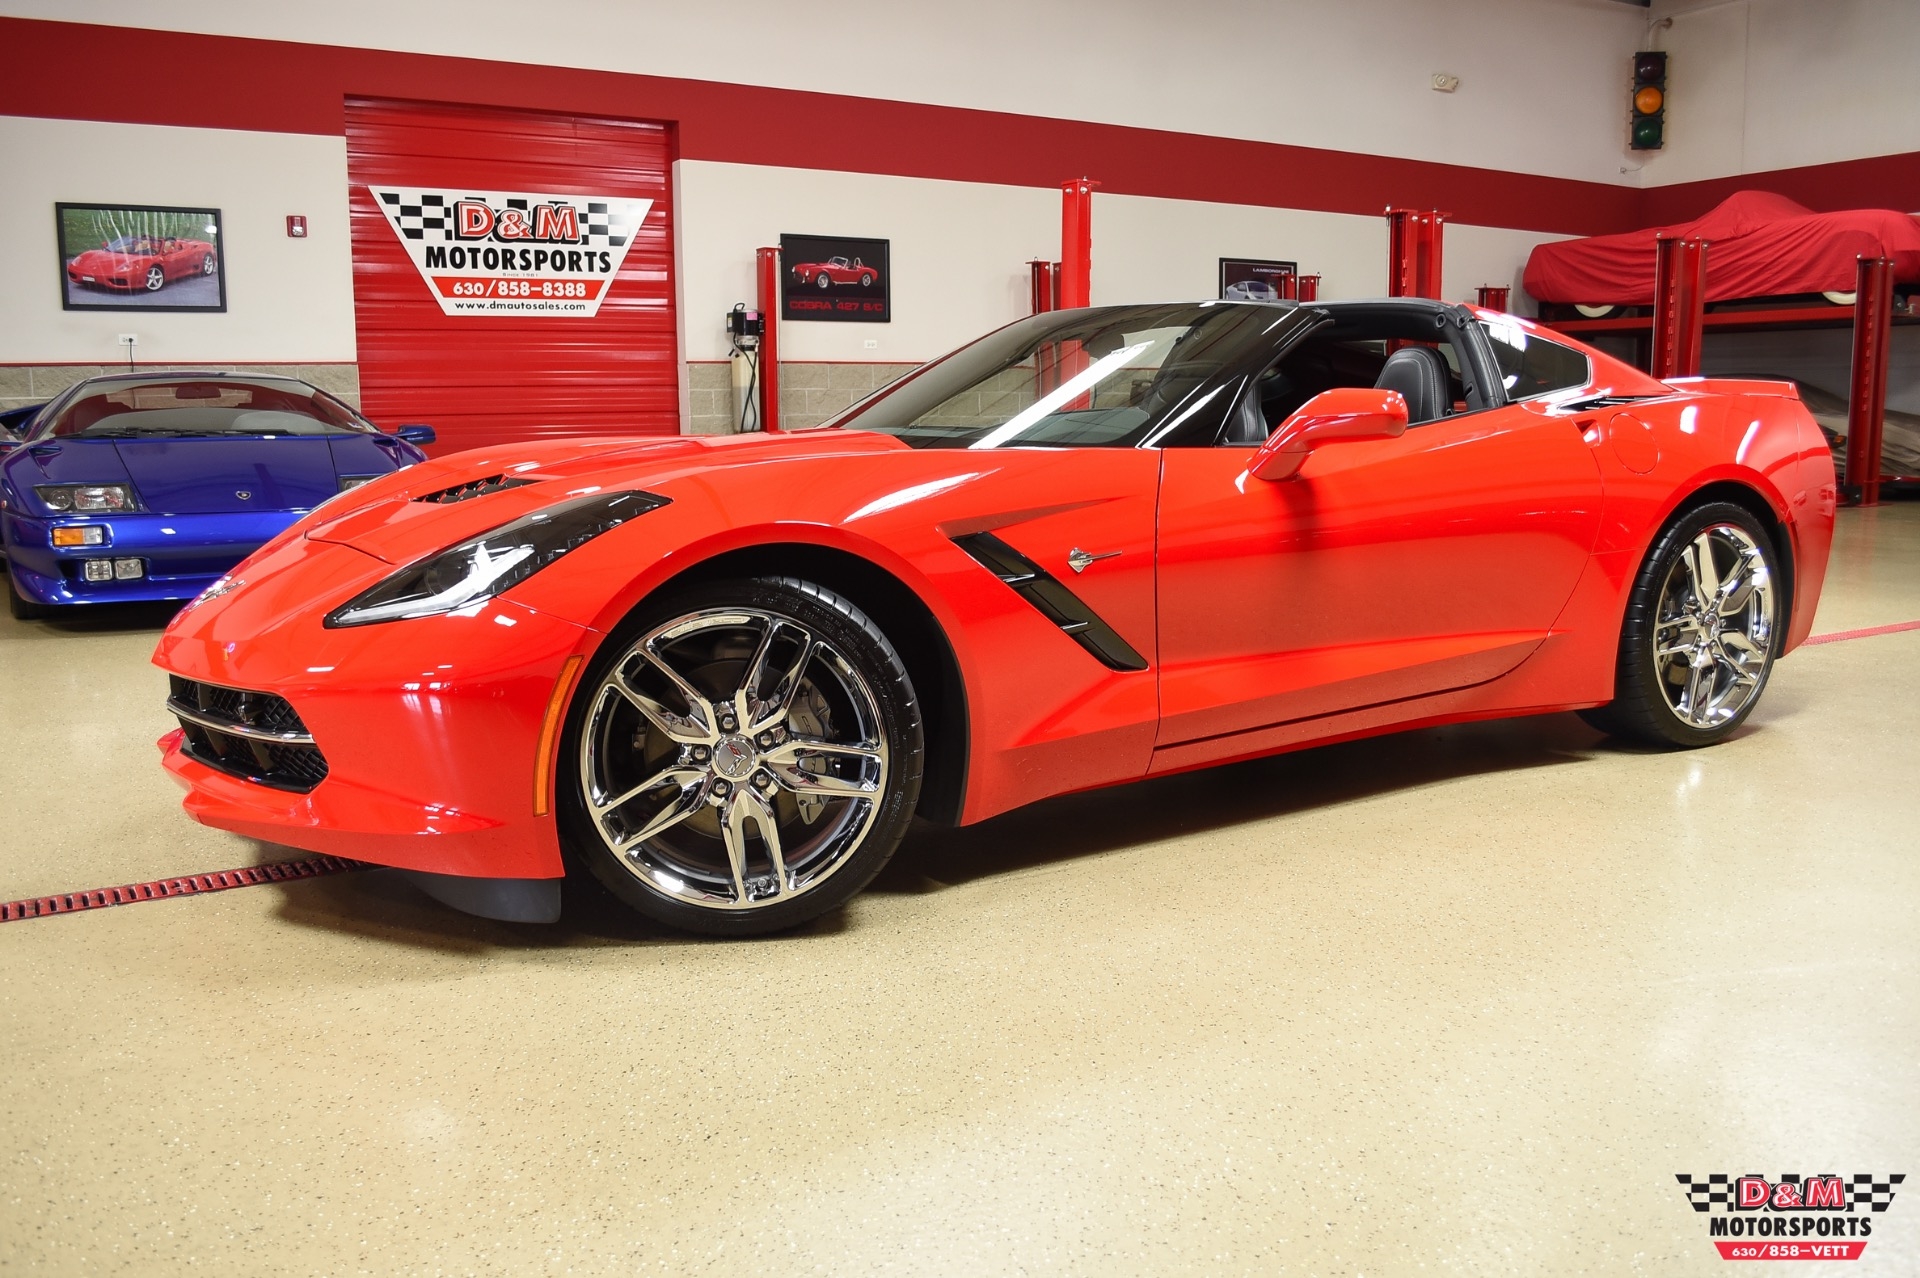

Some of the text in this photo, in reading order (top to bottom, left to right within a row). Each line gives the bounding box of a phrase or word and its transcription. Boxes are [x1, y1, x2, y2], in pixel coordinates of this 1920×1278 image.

[455, 201, 580, 243] D&M
[426, 246, 611, 273] MOTORSPORTS
[453, 279, 586, 297] 630/858-8388
[455, 301, 586, 311] www.dmautosales.com
[789, 301, 832, 310] COBRA
[837, 302, 859, 311] 427
